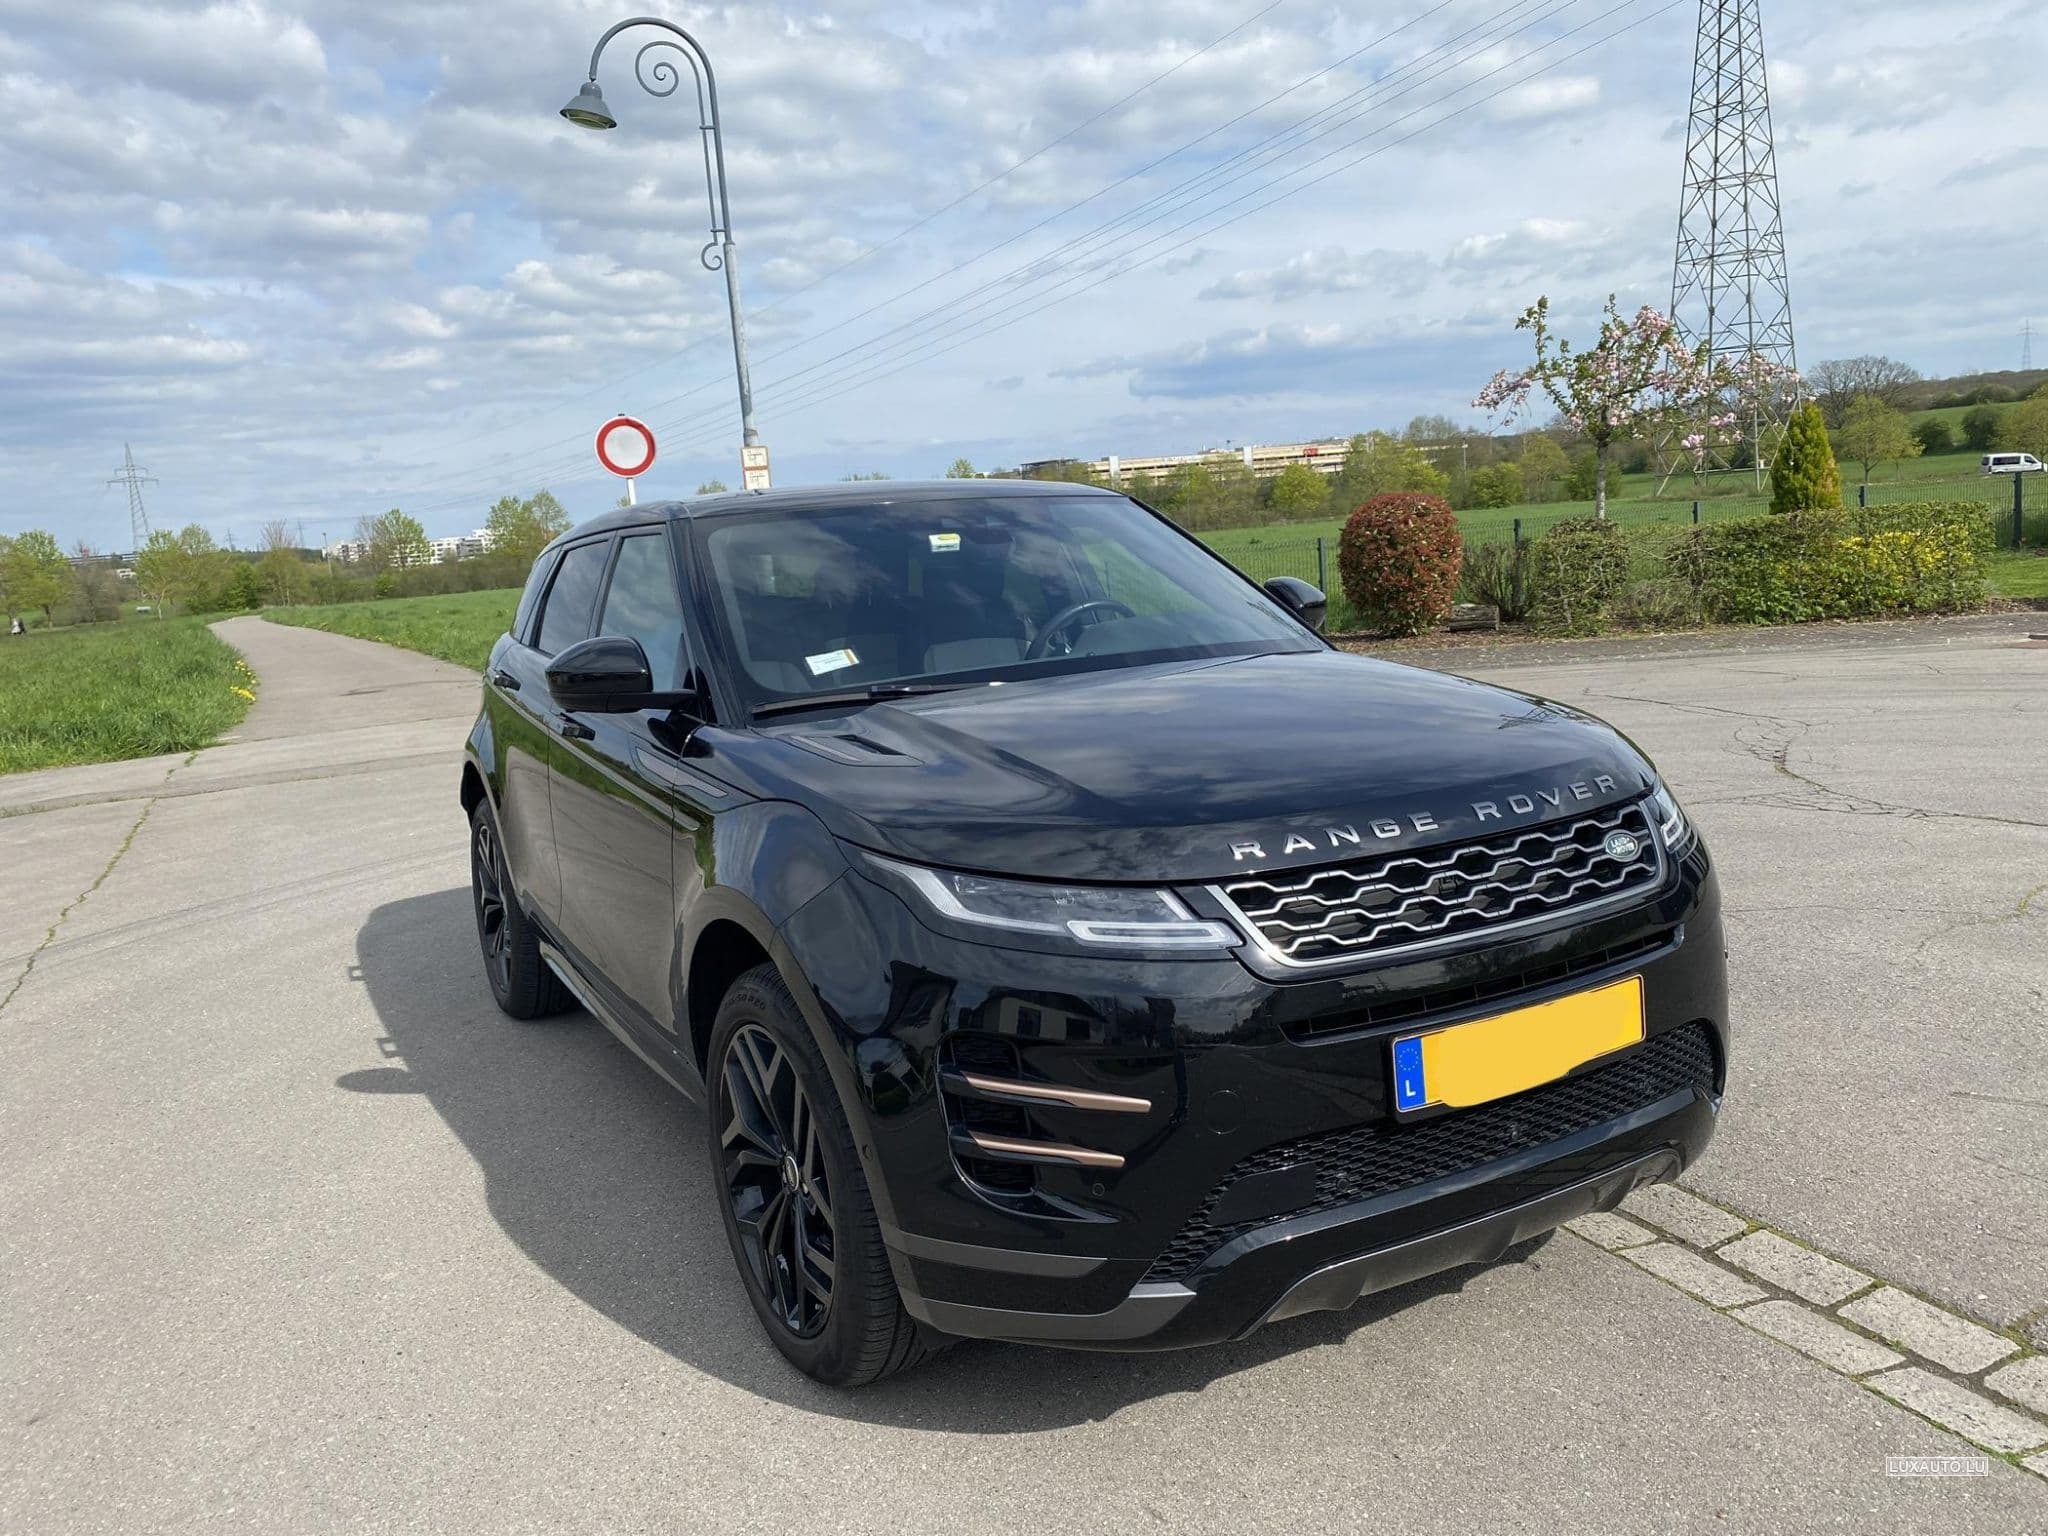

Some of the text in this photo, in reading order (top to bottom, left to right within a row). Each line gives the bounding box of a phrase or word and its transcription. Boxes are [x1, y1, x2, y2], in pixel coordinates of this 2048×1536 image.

[1229, 774, 1617, 860] RANGE ROVER
[1405, 1079, 1416, 1097] L
